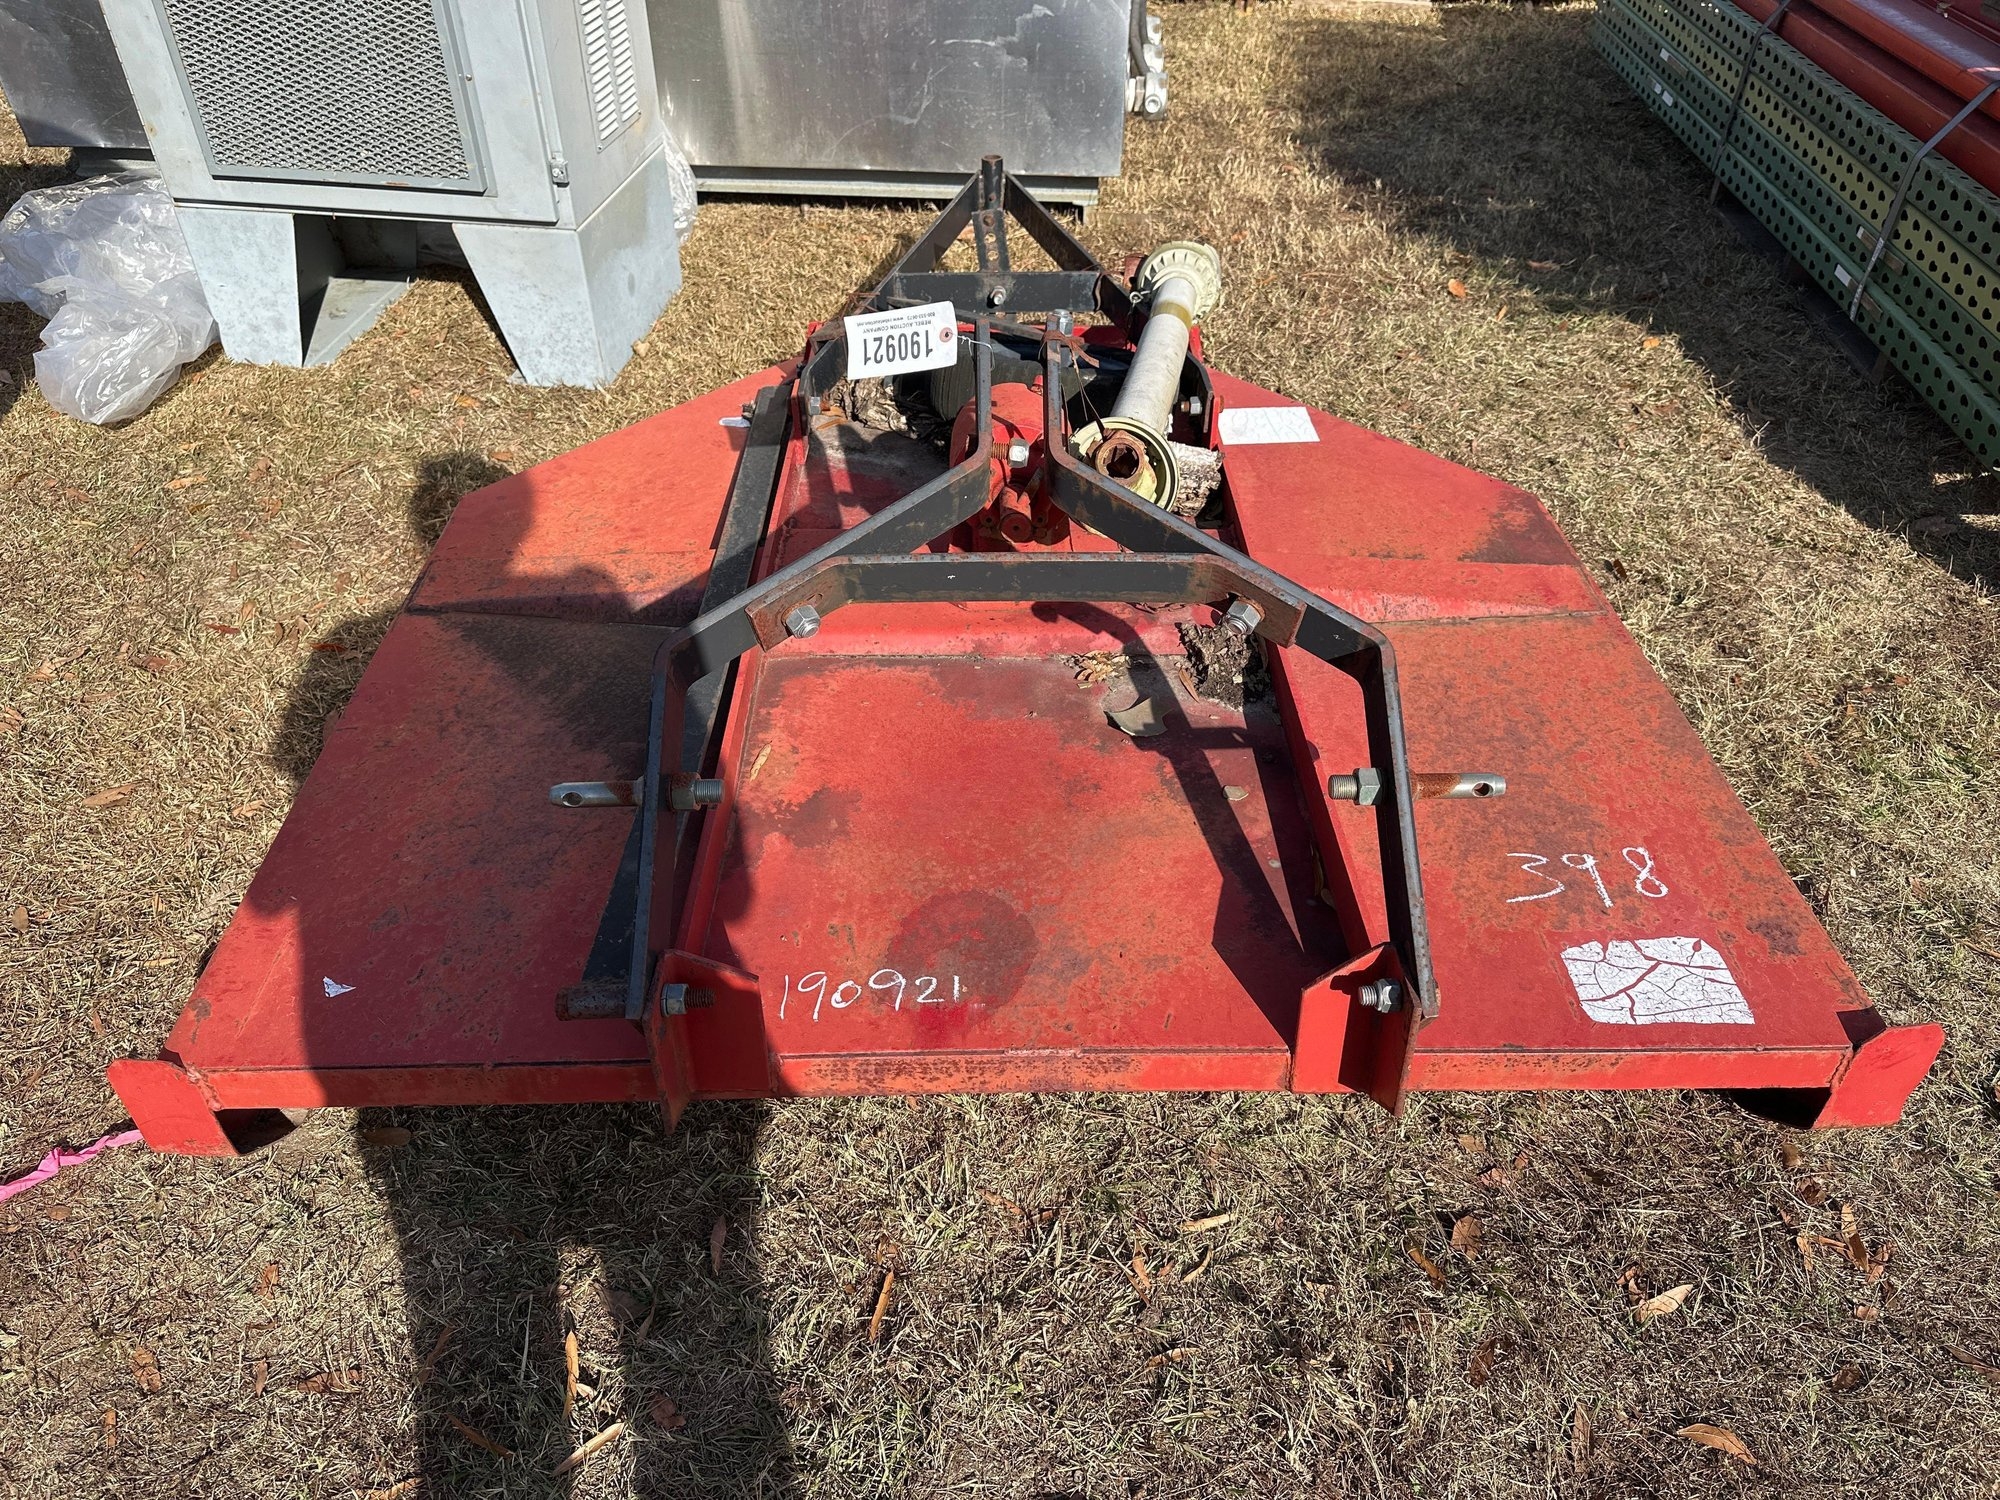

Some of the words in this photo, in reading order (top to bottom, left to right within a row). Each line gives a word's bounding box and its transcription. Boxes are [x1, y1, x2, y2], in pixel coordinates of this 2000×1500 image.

[863, 325, 889, 334] COMPANY
[889, 322, 913, 330] AUCTION
[863, 330, 933, 366] 190921
[1506, 846, 1669, 909] 398
[779, 968, 960, 1022] 190921
